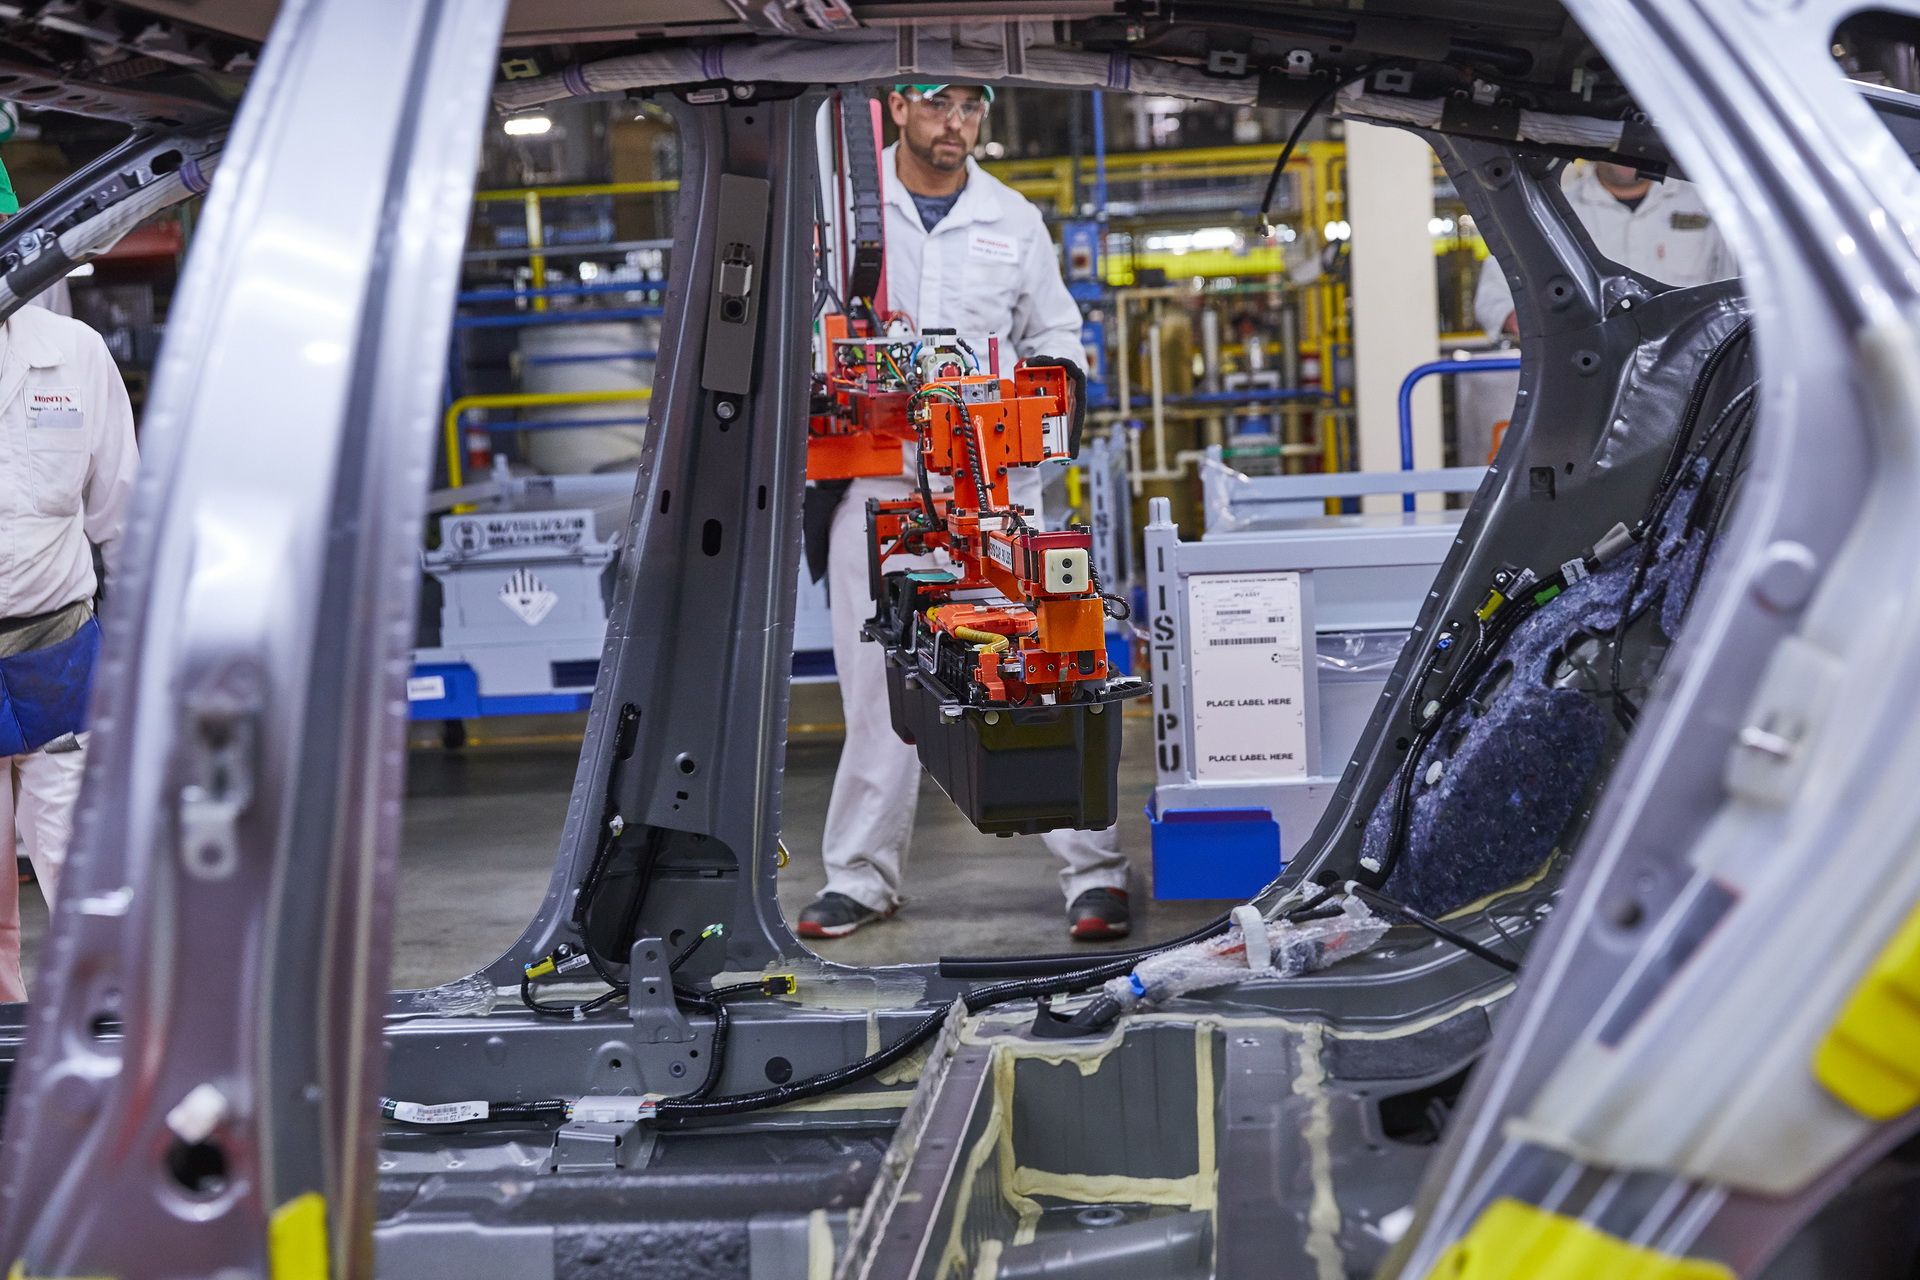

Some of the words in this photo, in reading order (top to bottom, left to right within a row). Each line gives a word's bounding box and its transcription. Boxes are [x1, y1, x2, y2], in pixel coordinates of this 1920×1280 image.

[1206, 699, 1235, 708] PLACE
[1238, 698, 1265, 707] LABEL
[1267, 697, 1292, 706] HERE
[1208, 754, 1237, 763] PLACE
[1239, 753, 1267, 762] LABEL
[1269, 752, 1294, 761] HERE
